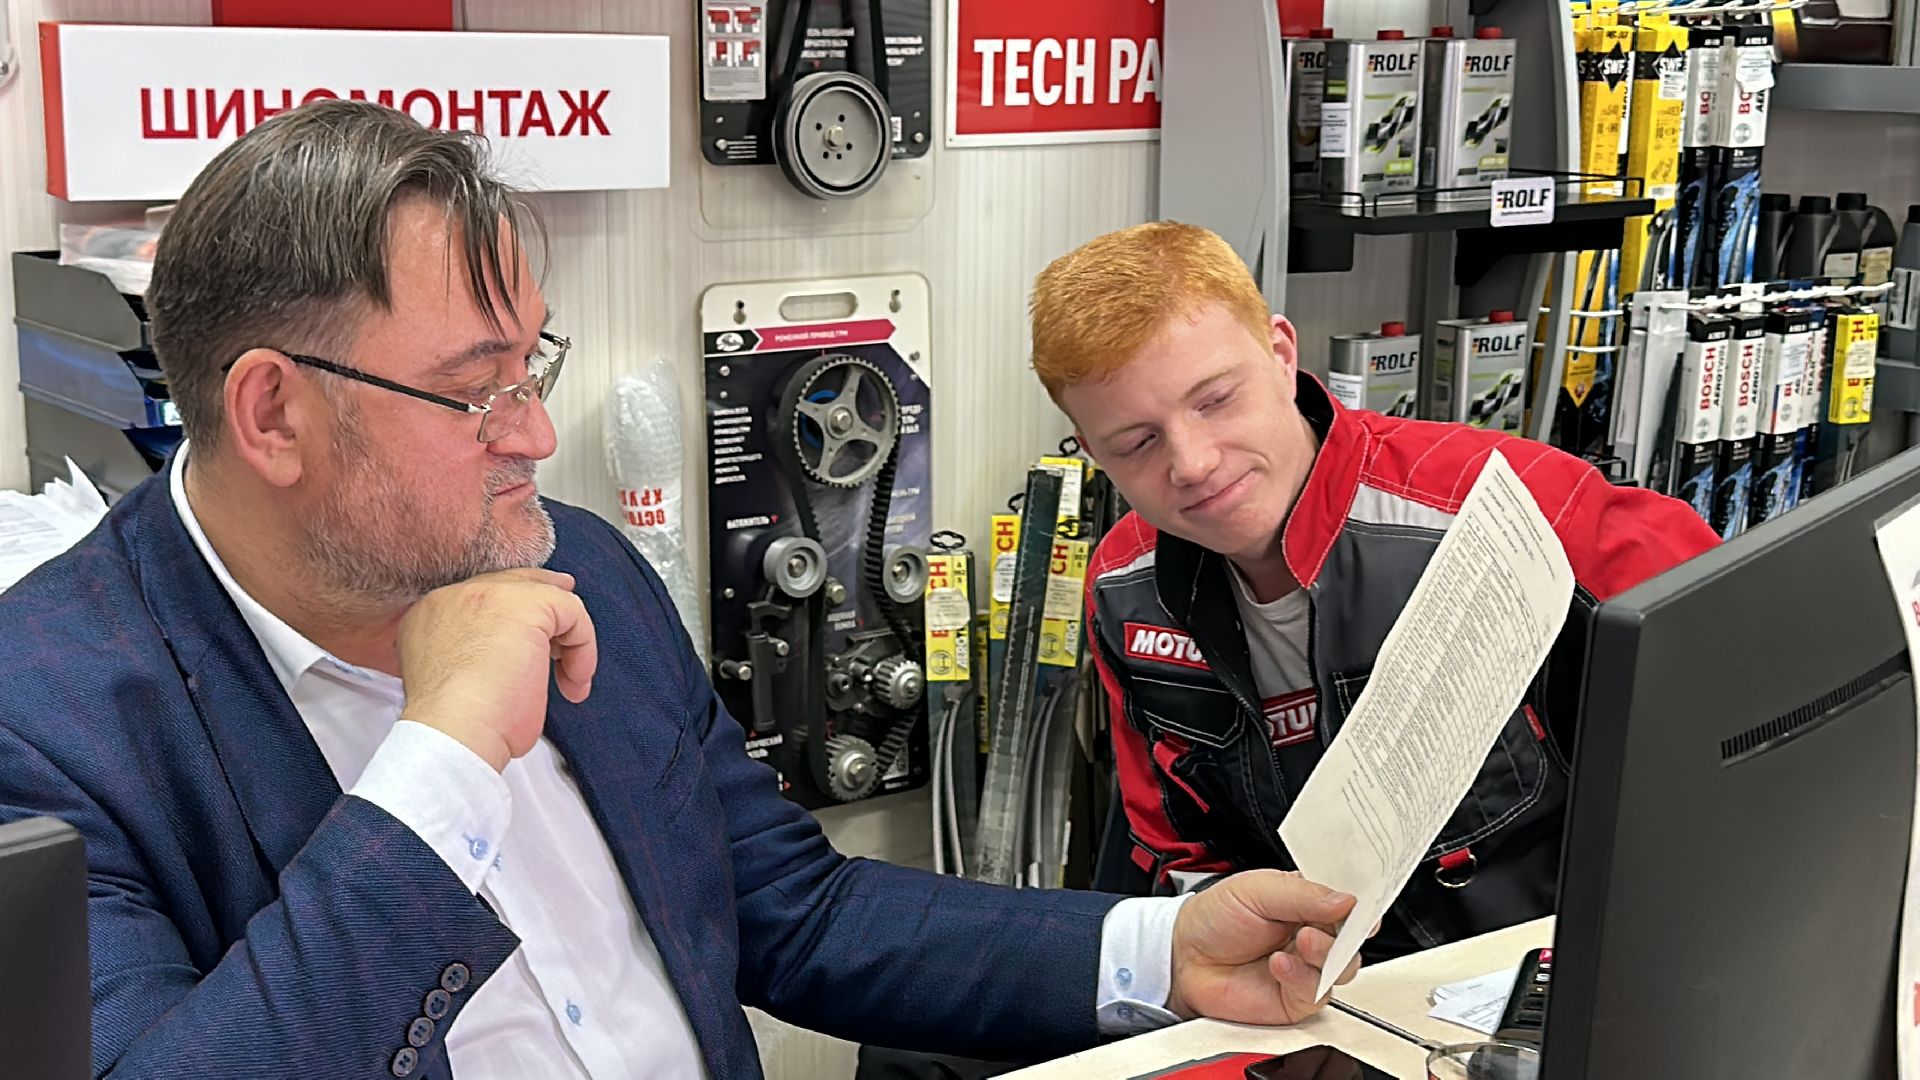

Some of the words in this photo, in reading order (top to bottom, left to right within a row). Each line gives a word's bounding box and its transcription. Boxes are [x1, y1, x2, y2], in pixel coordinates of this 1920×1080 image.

[973, 38, 1096, 107] TECH
[1373, 53, 1419, 72] ROLF
[1469, 54, 1513, 72] ROLF
[140, 87, 612, 139] ШИНОНТАЖ
[1501, 187, 1551, 209] ROLF
[1477, 334, 1526, 354] ROLF
[1375, 350, 1419, 372] ROLF
[1700, 346, 1717, 410] BOSCH
[1738, 344, 1754, 407] BOSCH
[1130, 628, 1206, 663] MOTU
